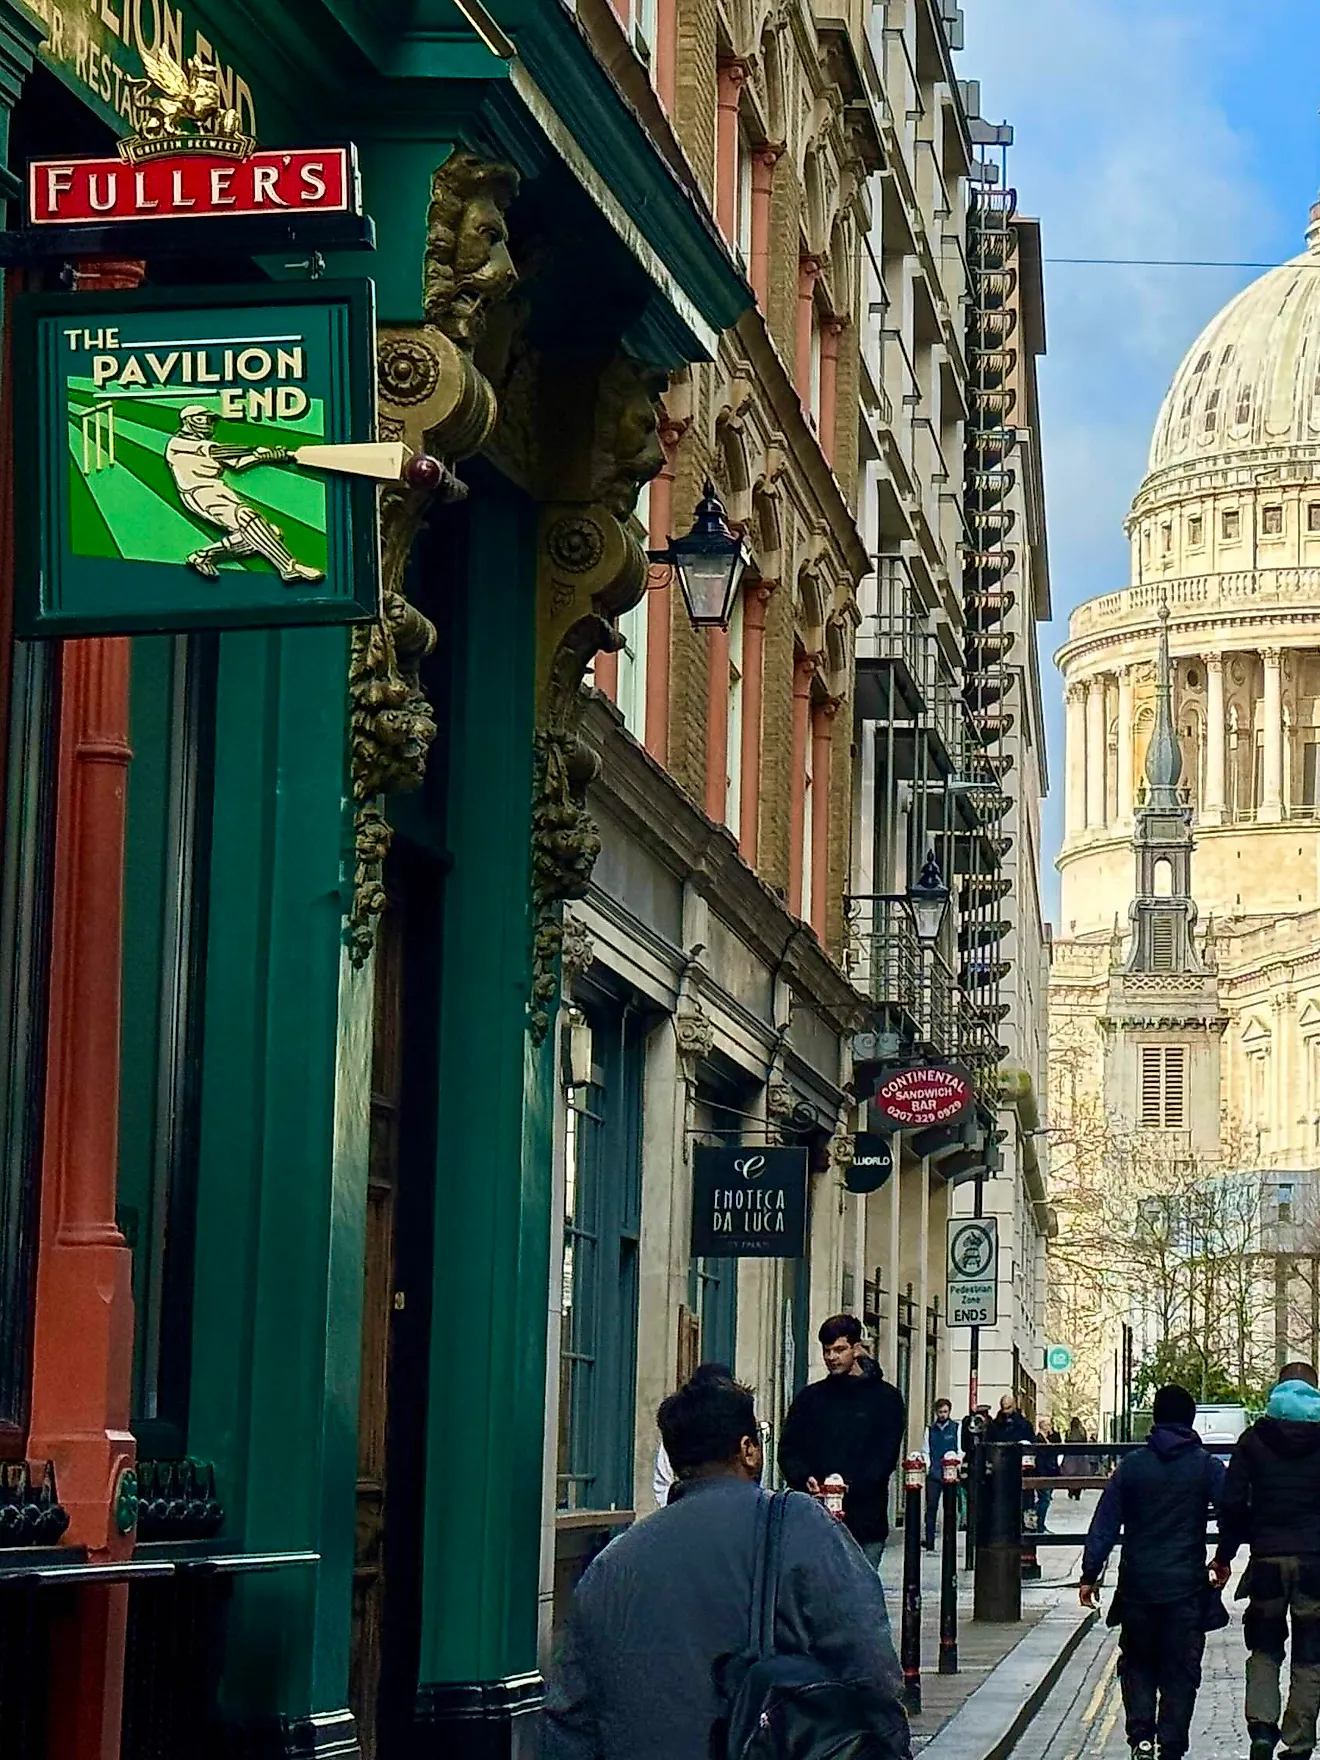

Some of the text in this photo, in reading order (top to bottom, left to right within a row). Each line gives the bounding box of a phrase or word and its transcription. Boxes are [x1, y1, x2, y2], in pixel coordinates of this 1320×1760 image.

[46, 154, 327, 212] FULLER'S
[63, 327, 120, 350] THE
[92, 346, 303, 387] PAVILION
[219, 386, 307, 419] END
[881, 1069, 966, 1098] CONTINENTAL
[895, 1086, 953, 1101] SANDWICH
[887, 1105, 913, 1122] 0207
[914, 1113, 936, 1123] 329
[911, 1099, 937, 1112] BAR
[713, 1211, 785, 1232] DA LUCA
[950, 1284, 993, 1295] Pedestrian
[961, 1295, 981, 1305] Zone
[954, 1308, 988, 1322] ENDS
